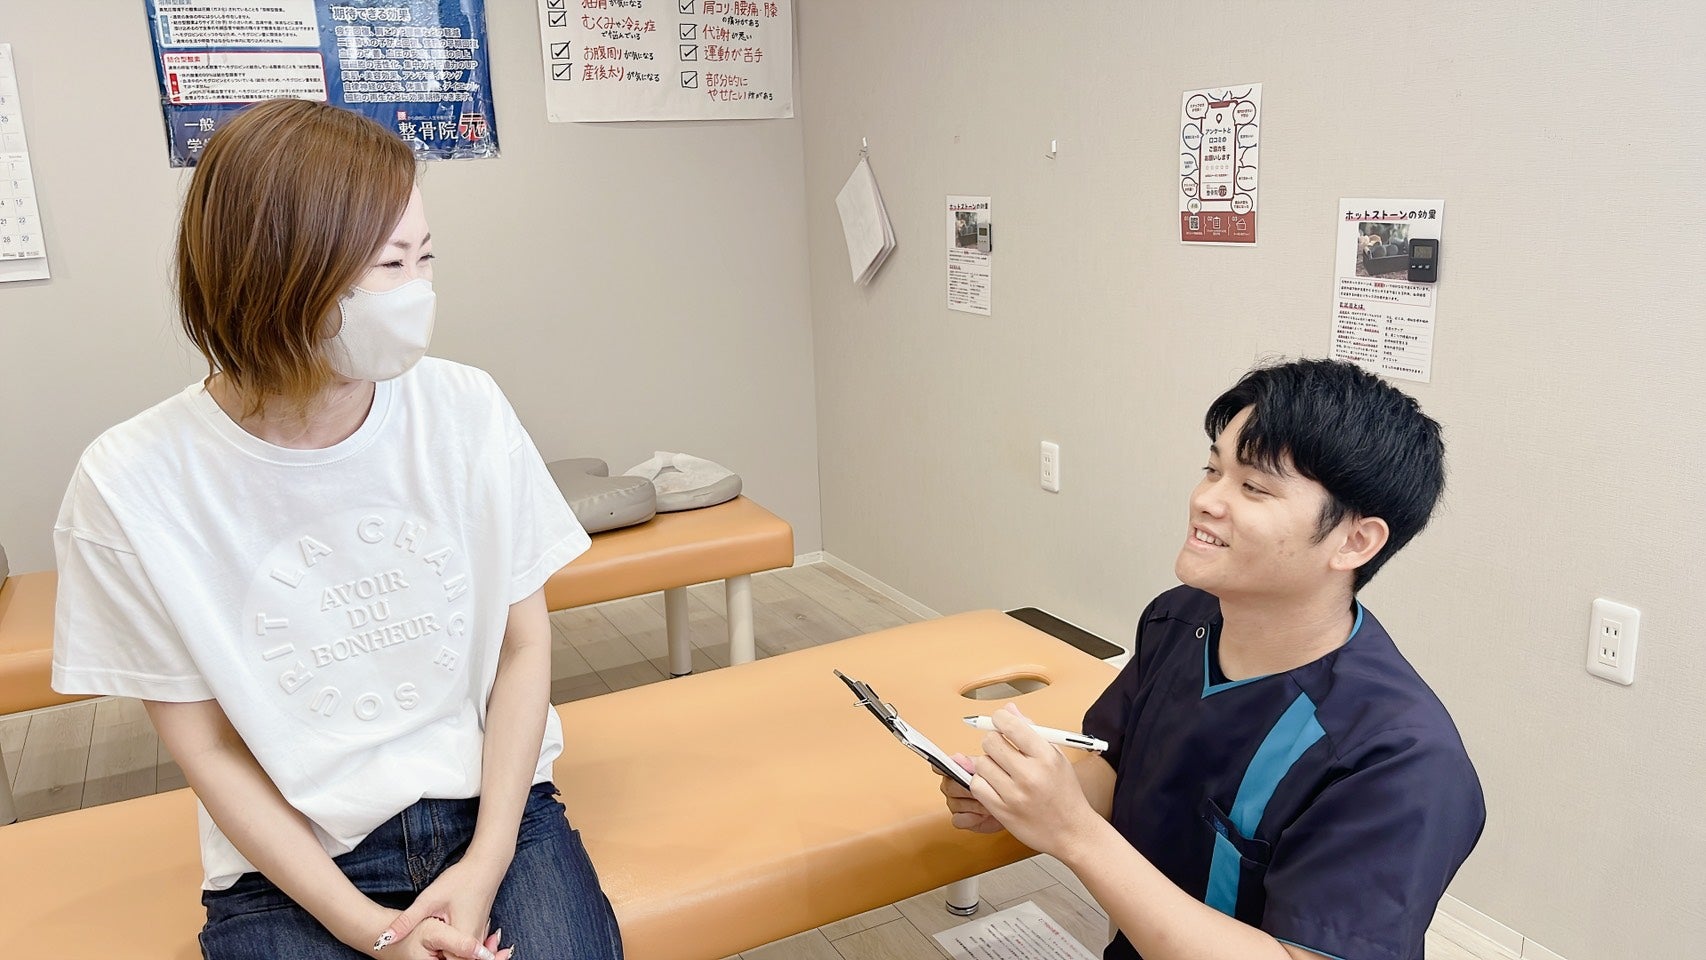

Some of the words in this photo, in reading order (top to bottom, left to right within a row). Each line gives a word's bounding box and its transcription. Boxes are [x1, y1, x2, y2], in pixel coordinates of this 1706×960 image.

[332, 6, 411, 22] 期待できる効果
[581, 14, 657, 33] むくみや冷え症
[703, 44, 763, 63] 運動が苦手
[705, 72, 749, 88] 部分的に
[184, 117, 215, 132] 一般
[398, 121, 458, 141] 整骨院
[460, 112, 487, 142] 元
[187, 138, 211, 153] 学
[1208, 136, 1227, 144] 口コミの
[1208, 145, 1226, 153] ご協力を
[1345, 209, 1437, 220] ホットストーンの効果
[270, 534, 334, 590] LA
[320, 568, 409, 612] AVOIR
[357, 514, 469, 672] CHANCE
[347, 599, 391, 629] DU
[310, 612, 441, 668] BONHEUR
[256, 612, 420, 721] SOURIT
